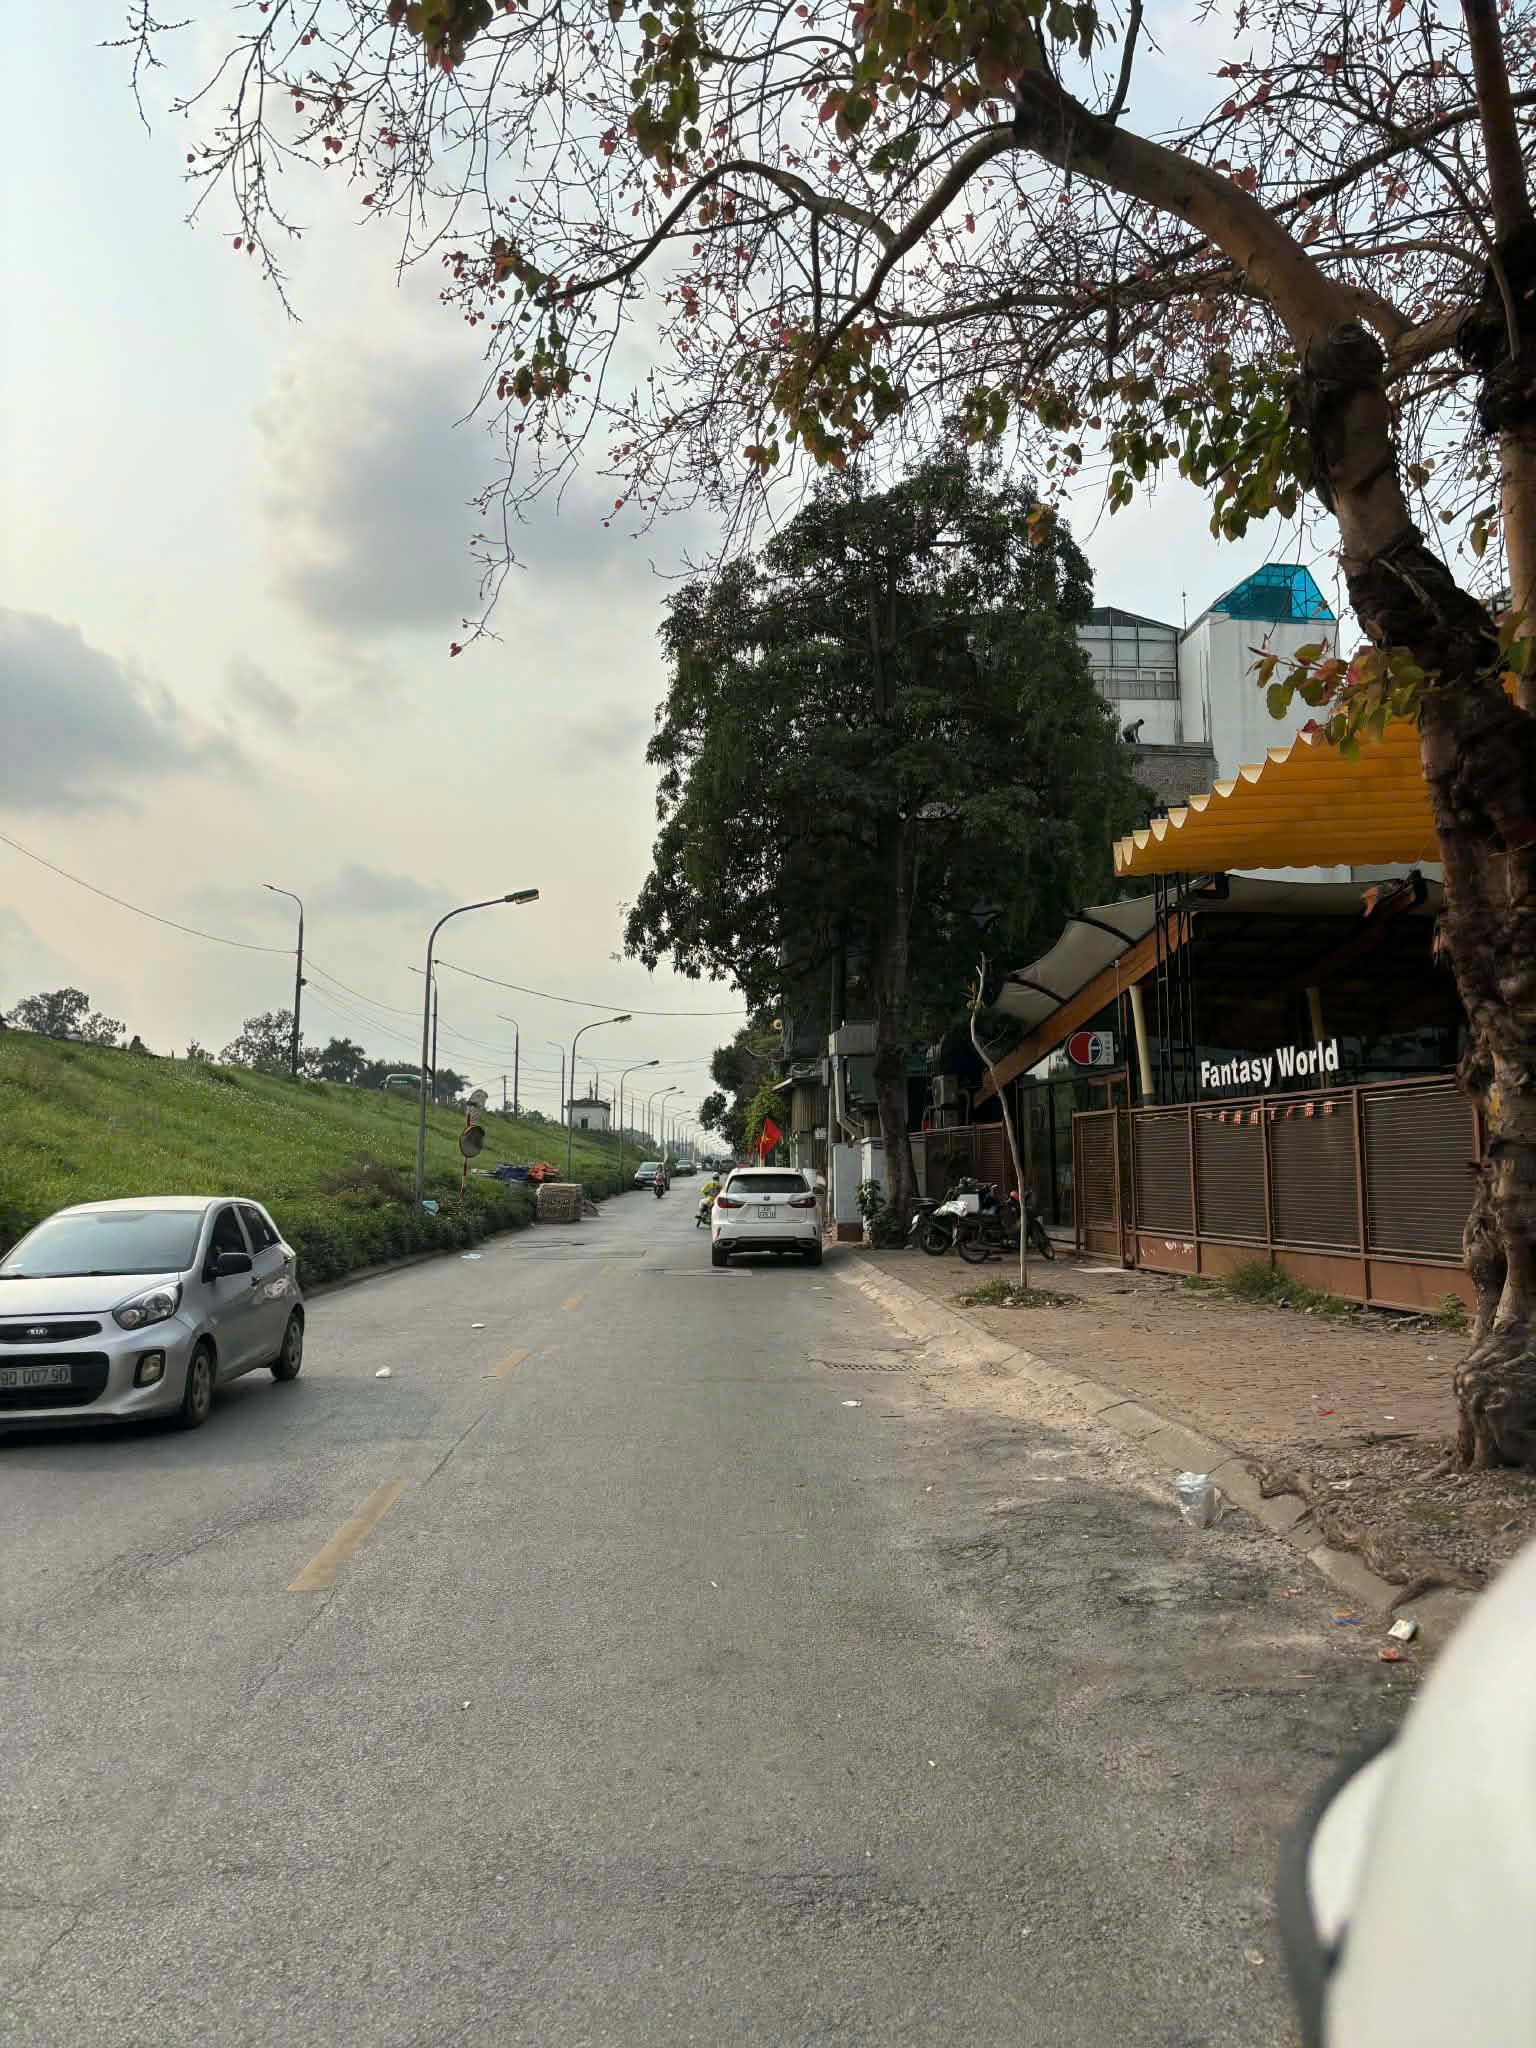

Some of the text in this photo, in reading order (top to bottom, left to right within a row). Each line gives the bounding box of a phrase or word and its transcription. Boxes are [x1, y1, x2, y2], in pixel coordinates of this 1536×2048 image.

[1201, 1038, 1339, 1088] Fantasy World
[29, 1327, 46, 1336] KIA
